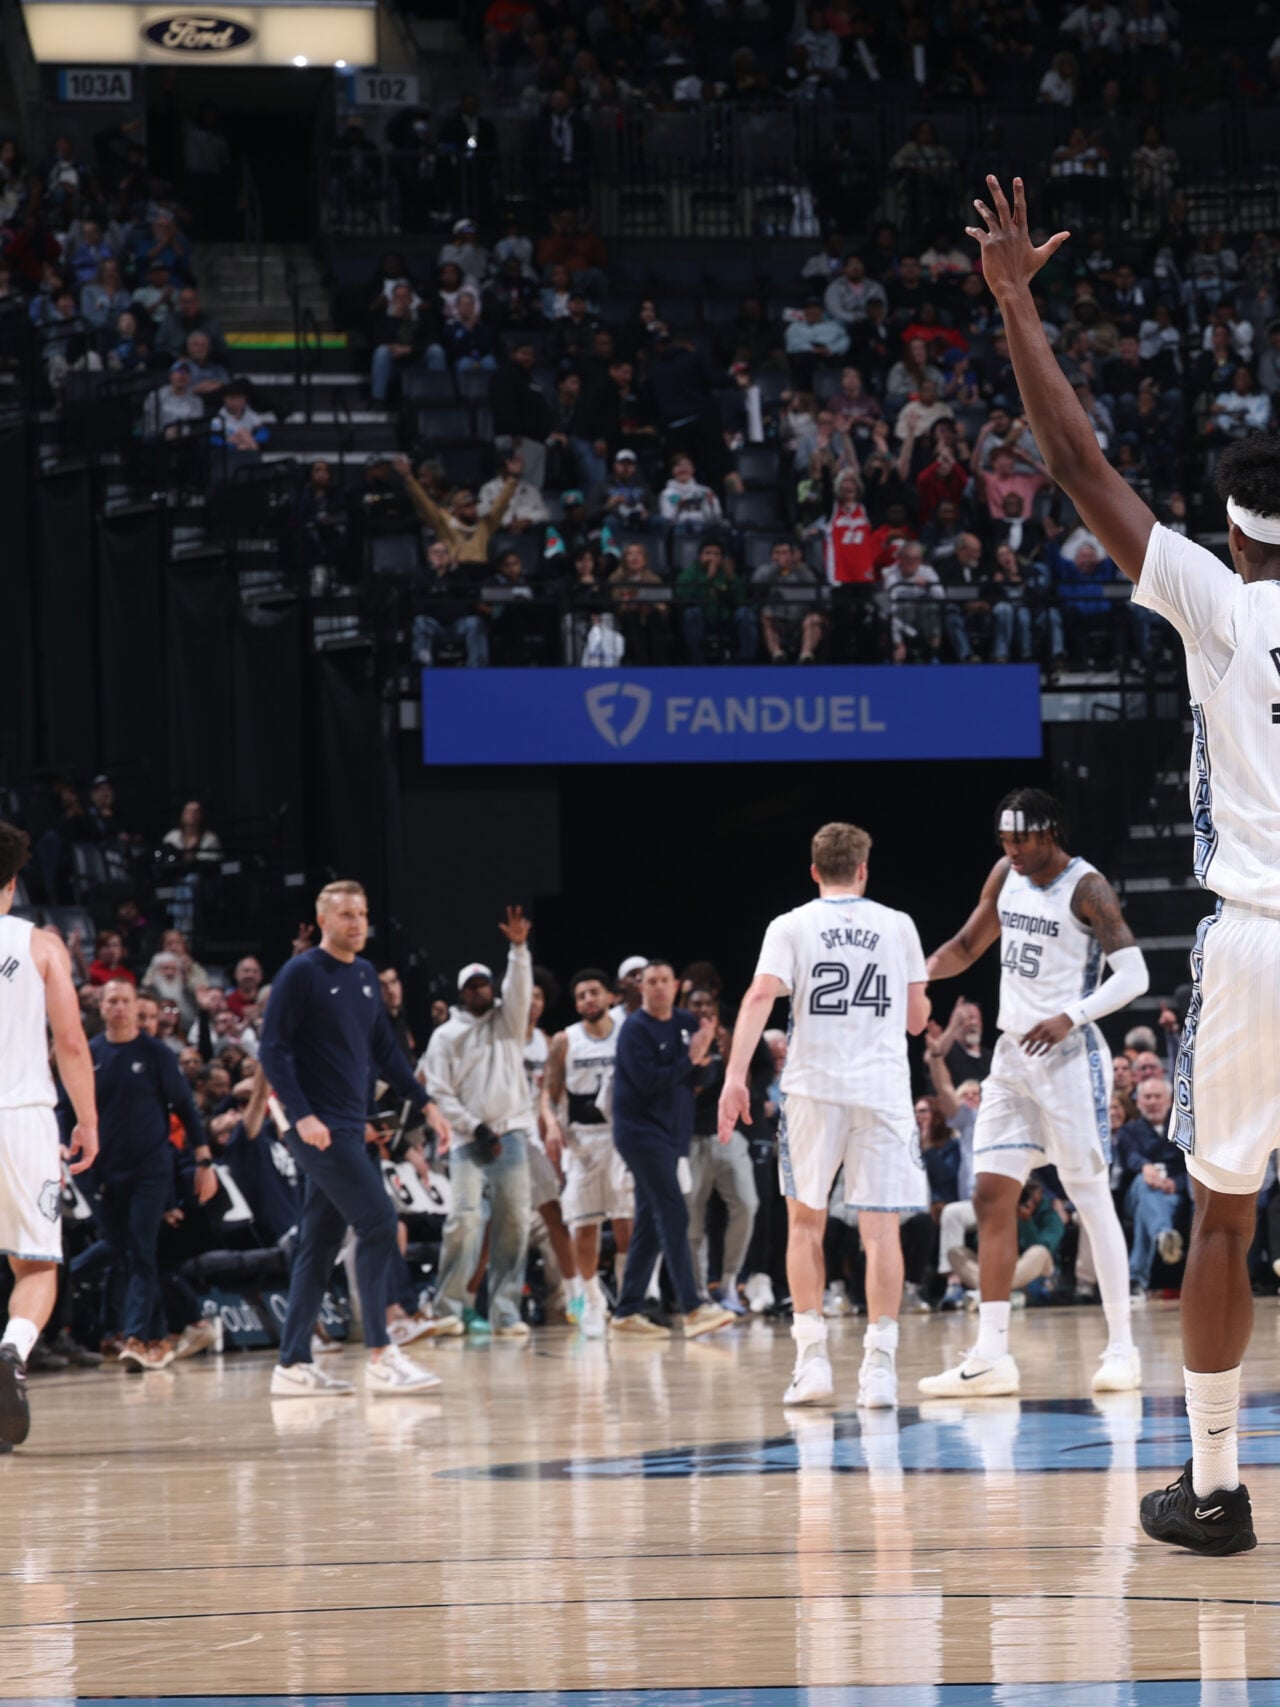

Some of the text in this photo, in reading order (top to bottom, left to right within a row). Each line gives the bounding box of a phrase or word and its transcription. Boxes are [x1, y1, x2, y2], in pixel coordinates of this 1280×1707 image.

[163, 18, 234, 48] Ford
[70, 74, 127, 97] 103A
[365, 79, 407, 100] 102
[666, 696, 886, 734] FANDUEL
[1001, 910, 1060, 938] memphis
[820, 928, 881, 952] SPENCER
[1000, 940, 1044, 979] 45
[809, 962, 892, 1017] 24
